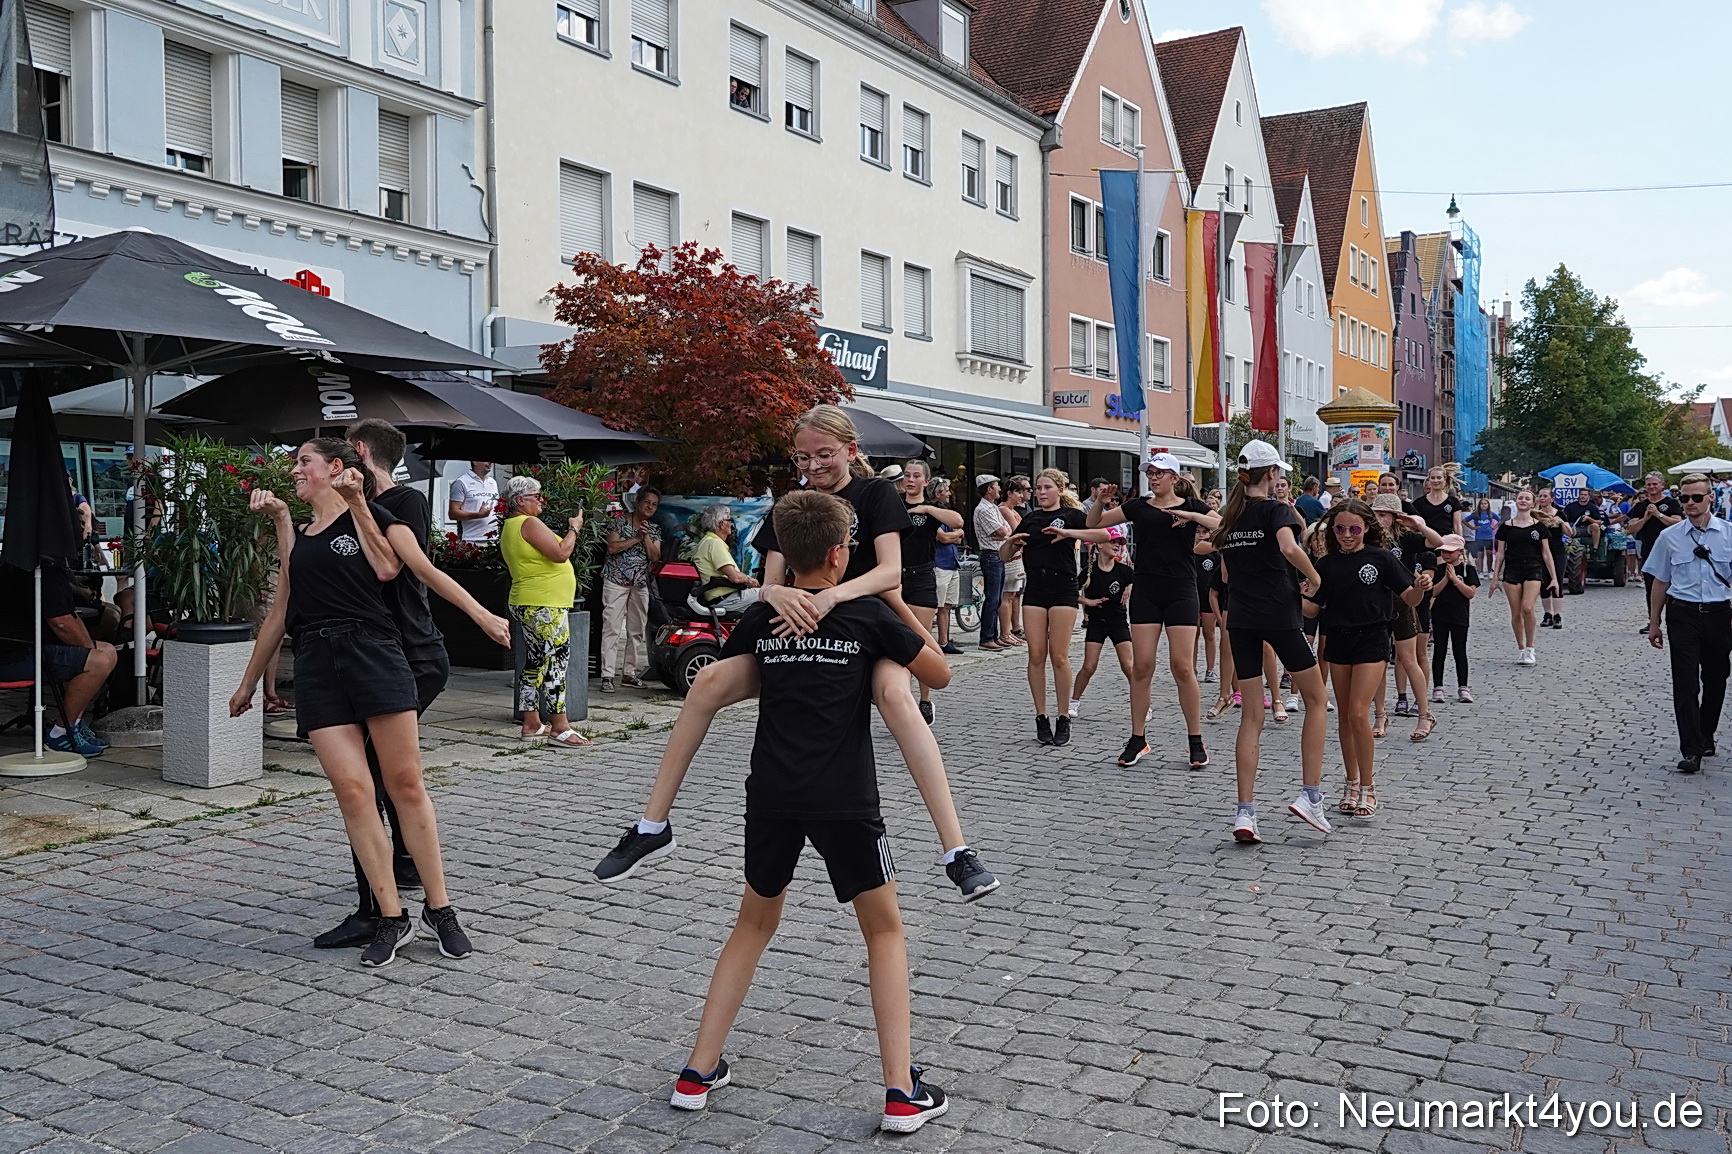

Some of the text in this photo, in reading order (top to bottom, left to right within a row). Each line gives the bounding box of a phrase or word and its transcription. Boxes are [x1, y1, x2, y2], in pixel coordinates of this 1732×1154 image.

[1564, 477, 1578, 487] SV
[1555, 488, 1580, 499] STAU
[755, 635, 862, 655] FUNNY ROLLERS
[815, 654, 849, 665] Neumarkt
